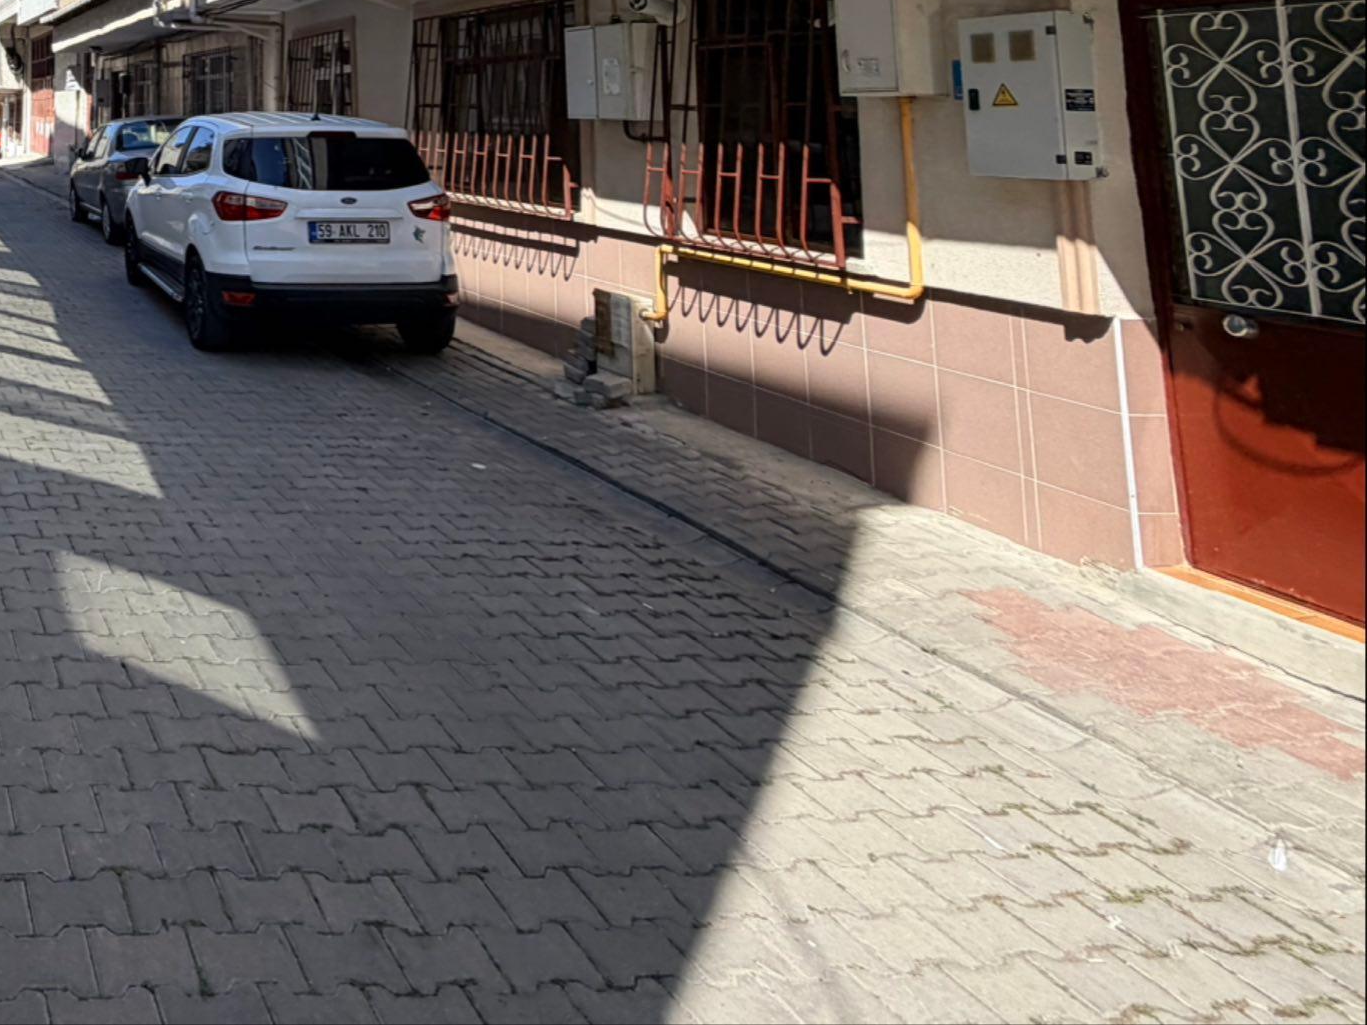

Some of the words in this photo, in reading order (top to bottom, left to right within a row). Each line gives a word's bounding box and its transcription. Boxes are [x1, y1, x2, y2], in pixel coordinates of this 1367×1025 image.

[318, 224, 332, 238] 59
[339, 224, 361, 238] AKL
[367, 224, 386, 238] 210
